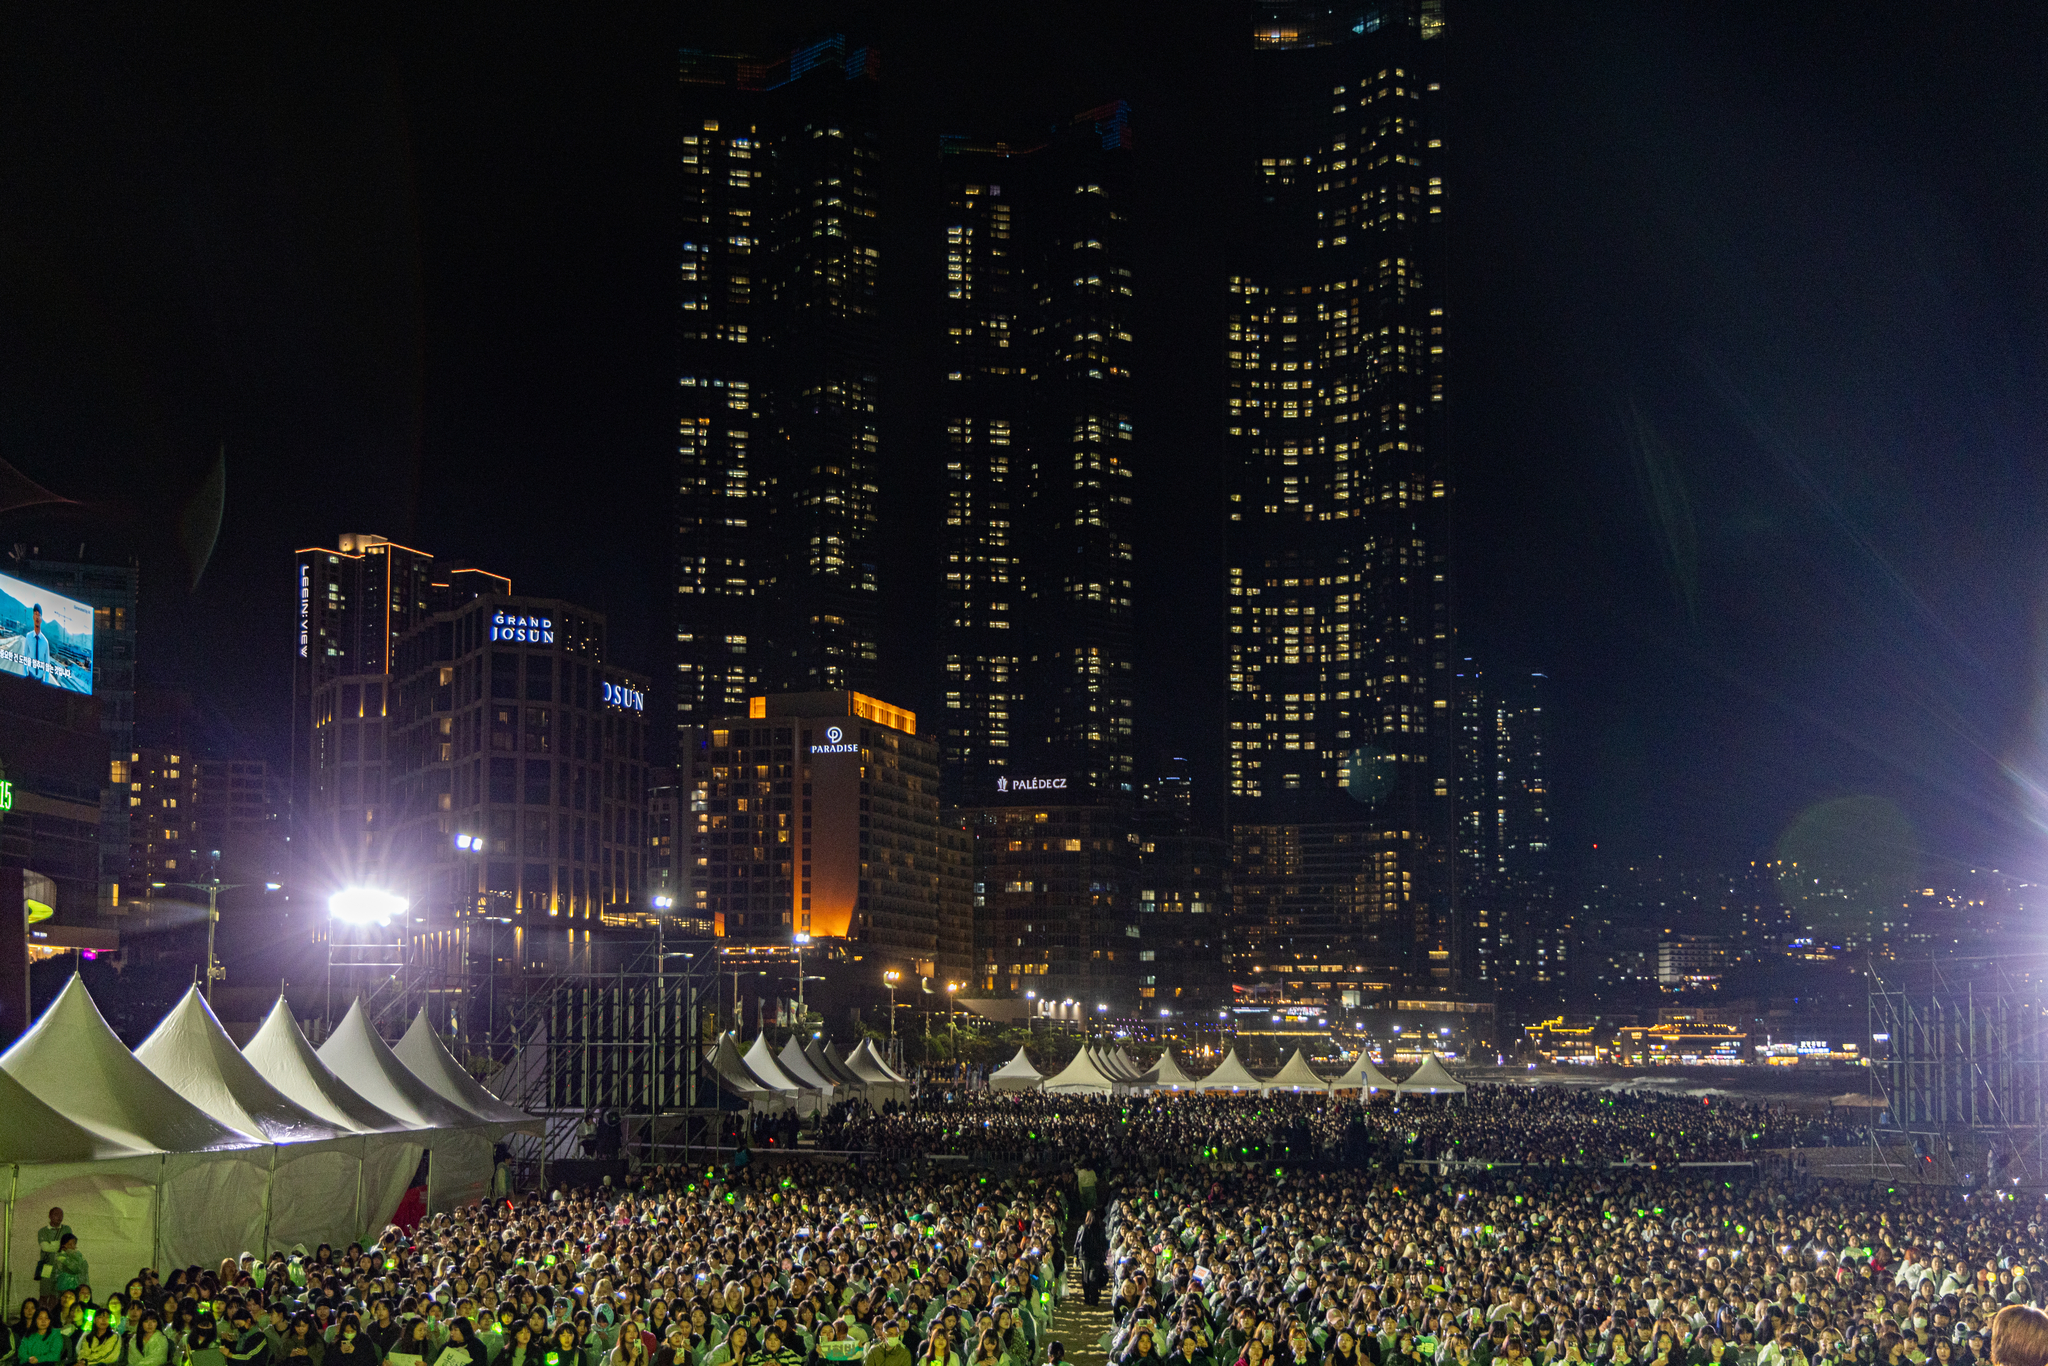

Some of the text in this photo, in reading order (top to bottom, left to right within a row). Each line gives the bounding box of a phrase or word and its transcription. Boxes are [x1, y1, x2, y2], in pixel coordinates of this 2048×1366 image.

[495, 616, 552, 628] GRAND
[491, 626, 554, 644] JOSUN
[811, 743, 859, 754] PARADISE
[1012, 776, 1067, 790] PALÉDECZ
